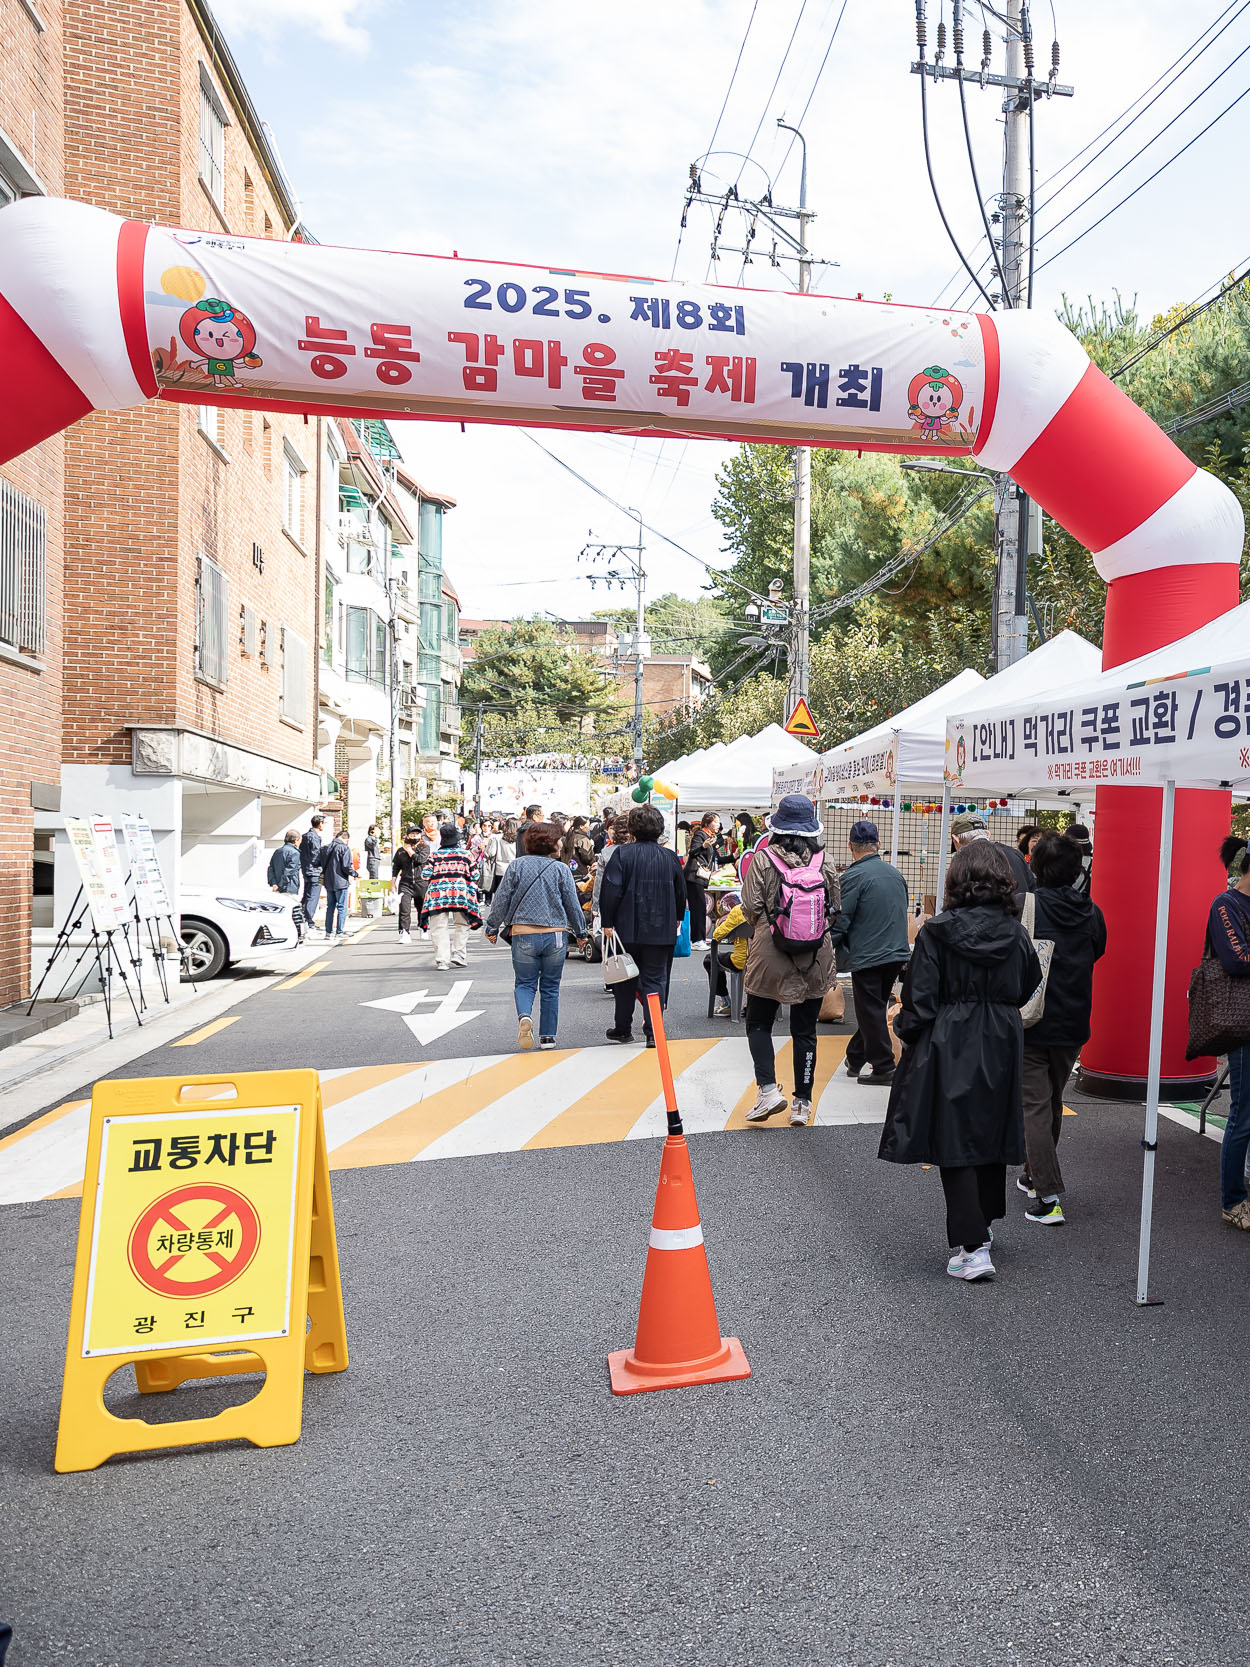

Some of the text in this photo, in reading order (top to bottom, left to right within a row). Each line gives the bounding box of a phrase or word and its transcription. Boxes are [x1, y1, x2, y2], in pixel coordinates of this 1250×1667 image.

[464, 279, 745, 335] 2025. 제8회
[298, 316, 882, 412] 능동 감마을 축제 개최
[972, 719, 1015, 762] [안내]
[1024, 709, 1074, 758] 먹거리
[1081, 702, 1121, 753] 쿠폰
[1129, 690, 1178, 747] 교환
[1054, 762, 1073, 780] 먹거리
[1074, 761, 1086, 780] 쿠폰
[1089, 759, 1108, 779] 교환은
[1110, 756, 1140, 777] 여기서!!!
[1218, 905, 1232, 929] POLO
[127, 1129, 277, 1173] 교통차단
[156, 1229, 234, 1255] 차량통제
